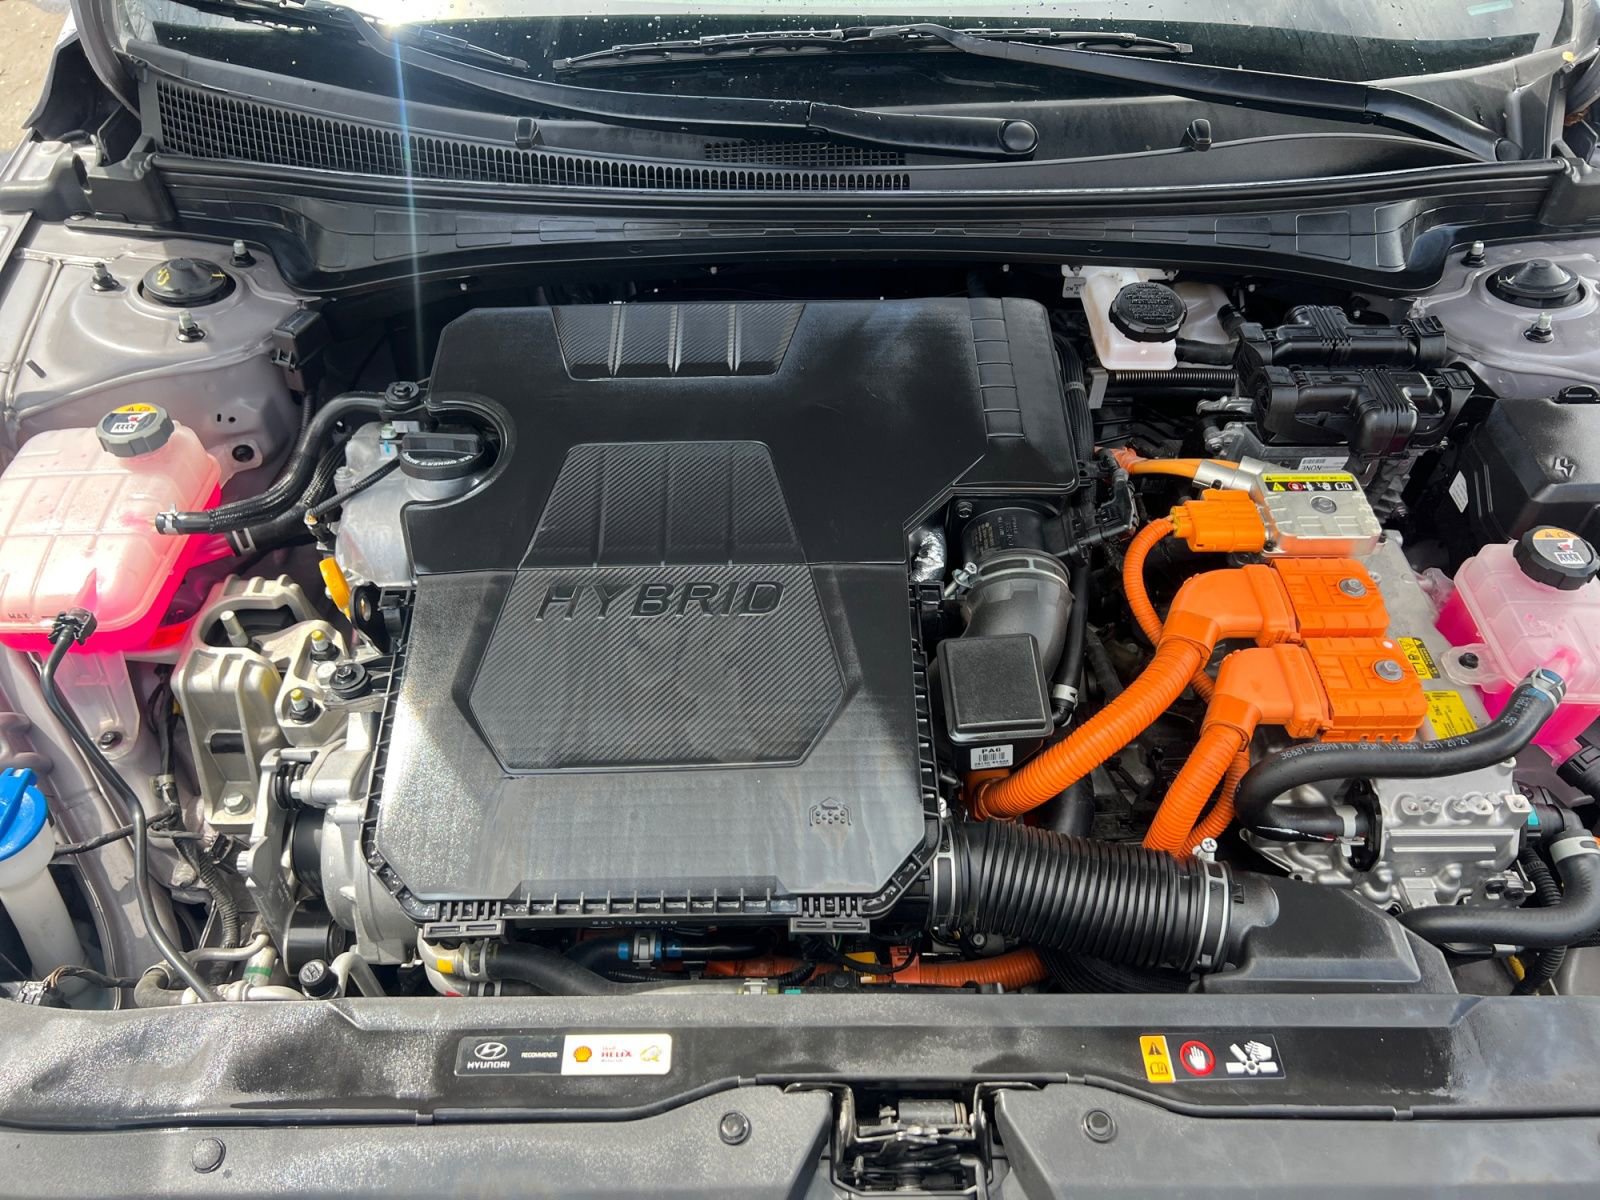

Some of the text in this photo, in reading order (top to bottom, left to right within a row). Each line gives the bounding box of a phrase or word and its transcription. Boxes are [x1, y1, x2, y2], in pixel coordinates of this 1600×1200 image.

[535, 581, 785, 621] HYBRID
[467, 1051, 558, 1069] HYUNDAI RECOMMENDS
[601, 1049, 632, 1058] HELIX
